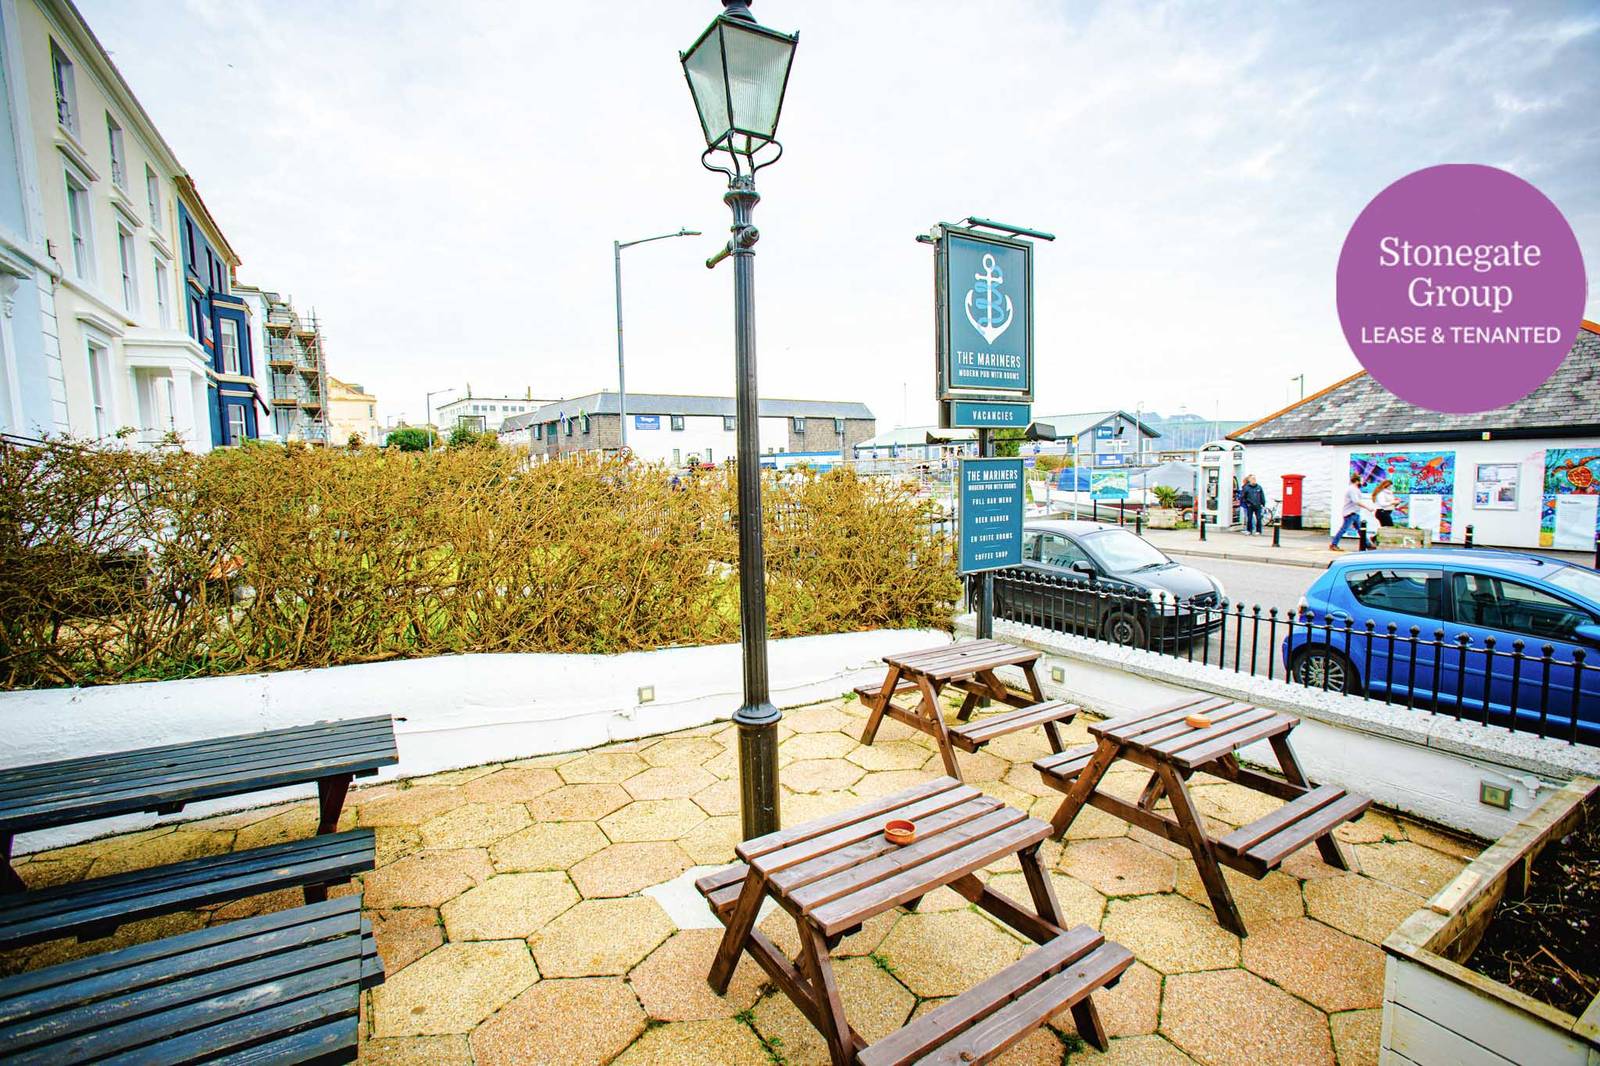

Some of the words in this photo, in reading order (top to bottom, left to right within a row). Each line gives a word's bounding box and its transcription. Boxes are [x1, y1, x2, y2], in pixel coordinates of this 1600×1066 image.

[957, 351, 974, 365] THE
[977, 352, 1021, 369] MARINERS
[959, 369, 979, 378] MODERN
[980, 370, 990, 378] PUB
[991, 371, 1003, 379] WITH
[1003, 372, 1020, 380] ROOMS
[972, 410, 1014, 421] VACANCIES
[967, 470, 981, 482] THE
[983, 469, 1018, 482] MARINERS
[999, 496, 1012, 504] MENU
[975, 516, 988, 524] BEER
[990, 515, 1009, 523] GARDEN
[980, 533, 995, 542] SUITE
[996, 532, 1013, 540] ROOMS
[975, 552, 994, 561] COFFEE
[995, 551, 1009, 559] SHOP
